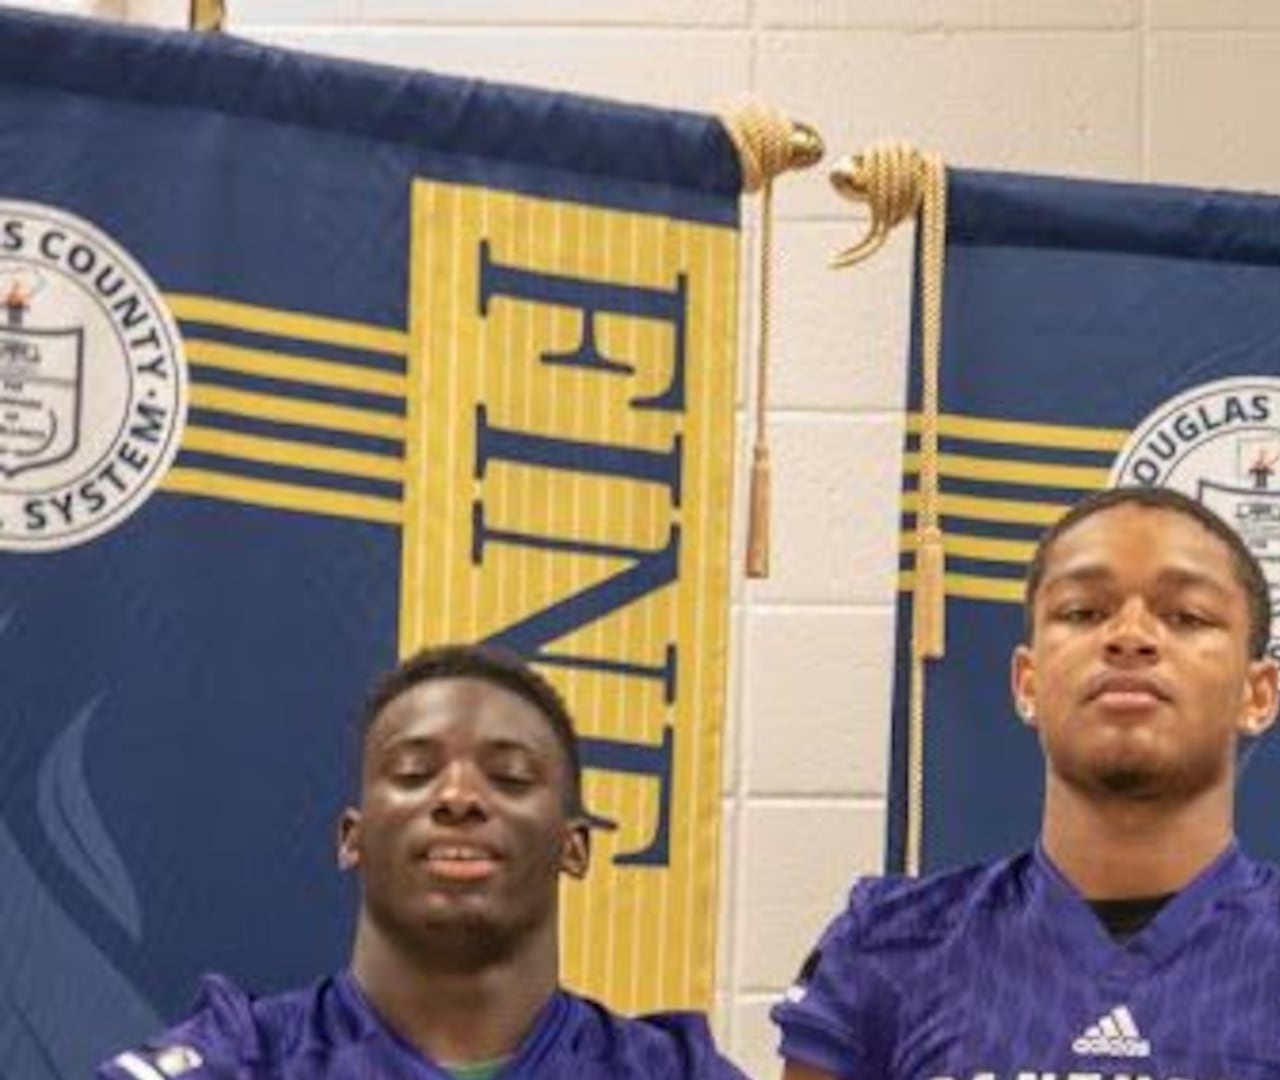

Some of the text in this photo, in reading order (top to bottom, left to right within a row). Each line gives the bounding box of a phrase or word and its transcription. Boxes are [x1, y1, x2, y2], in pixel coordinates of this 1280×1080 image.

[40, 230, 168, 379] COUNTY
[24, 402, 166, 530] SYSTEM
[1132, 395, 1270, 483] OUGLAS
